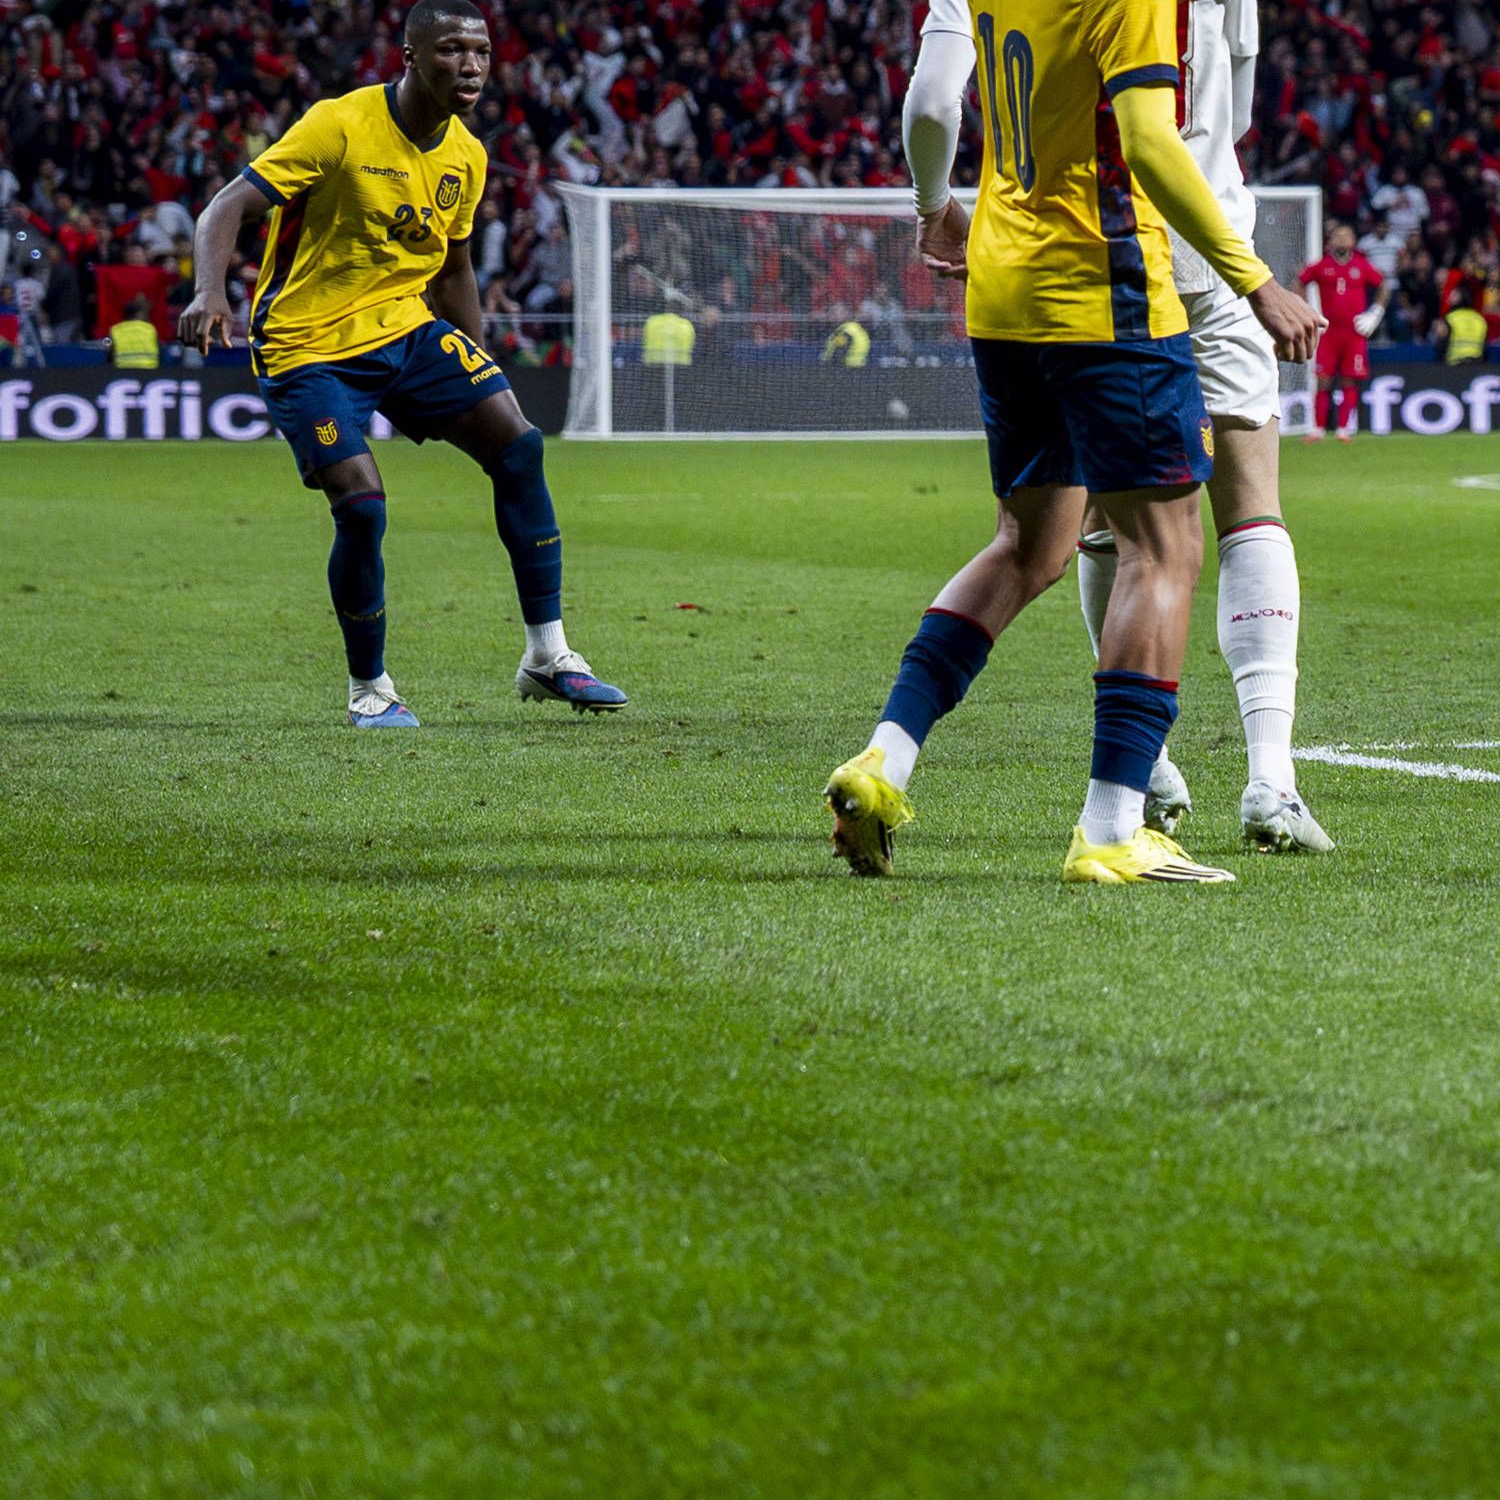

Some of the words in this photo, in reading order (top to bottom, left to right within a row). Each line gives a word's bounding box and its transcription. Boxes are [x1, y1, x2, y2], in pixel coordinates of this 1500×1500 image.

[977, 11, 1036, 194] 10
[360, 164, 410, 180] marathon
[387, 203, 433, 243] 23
